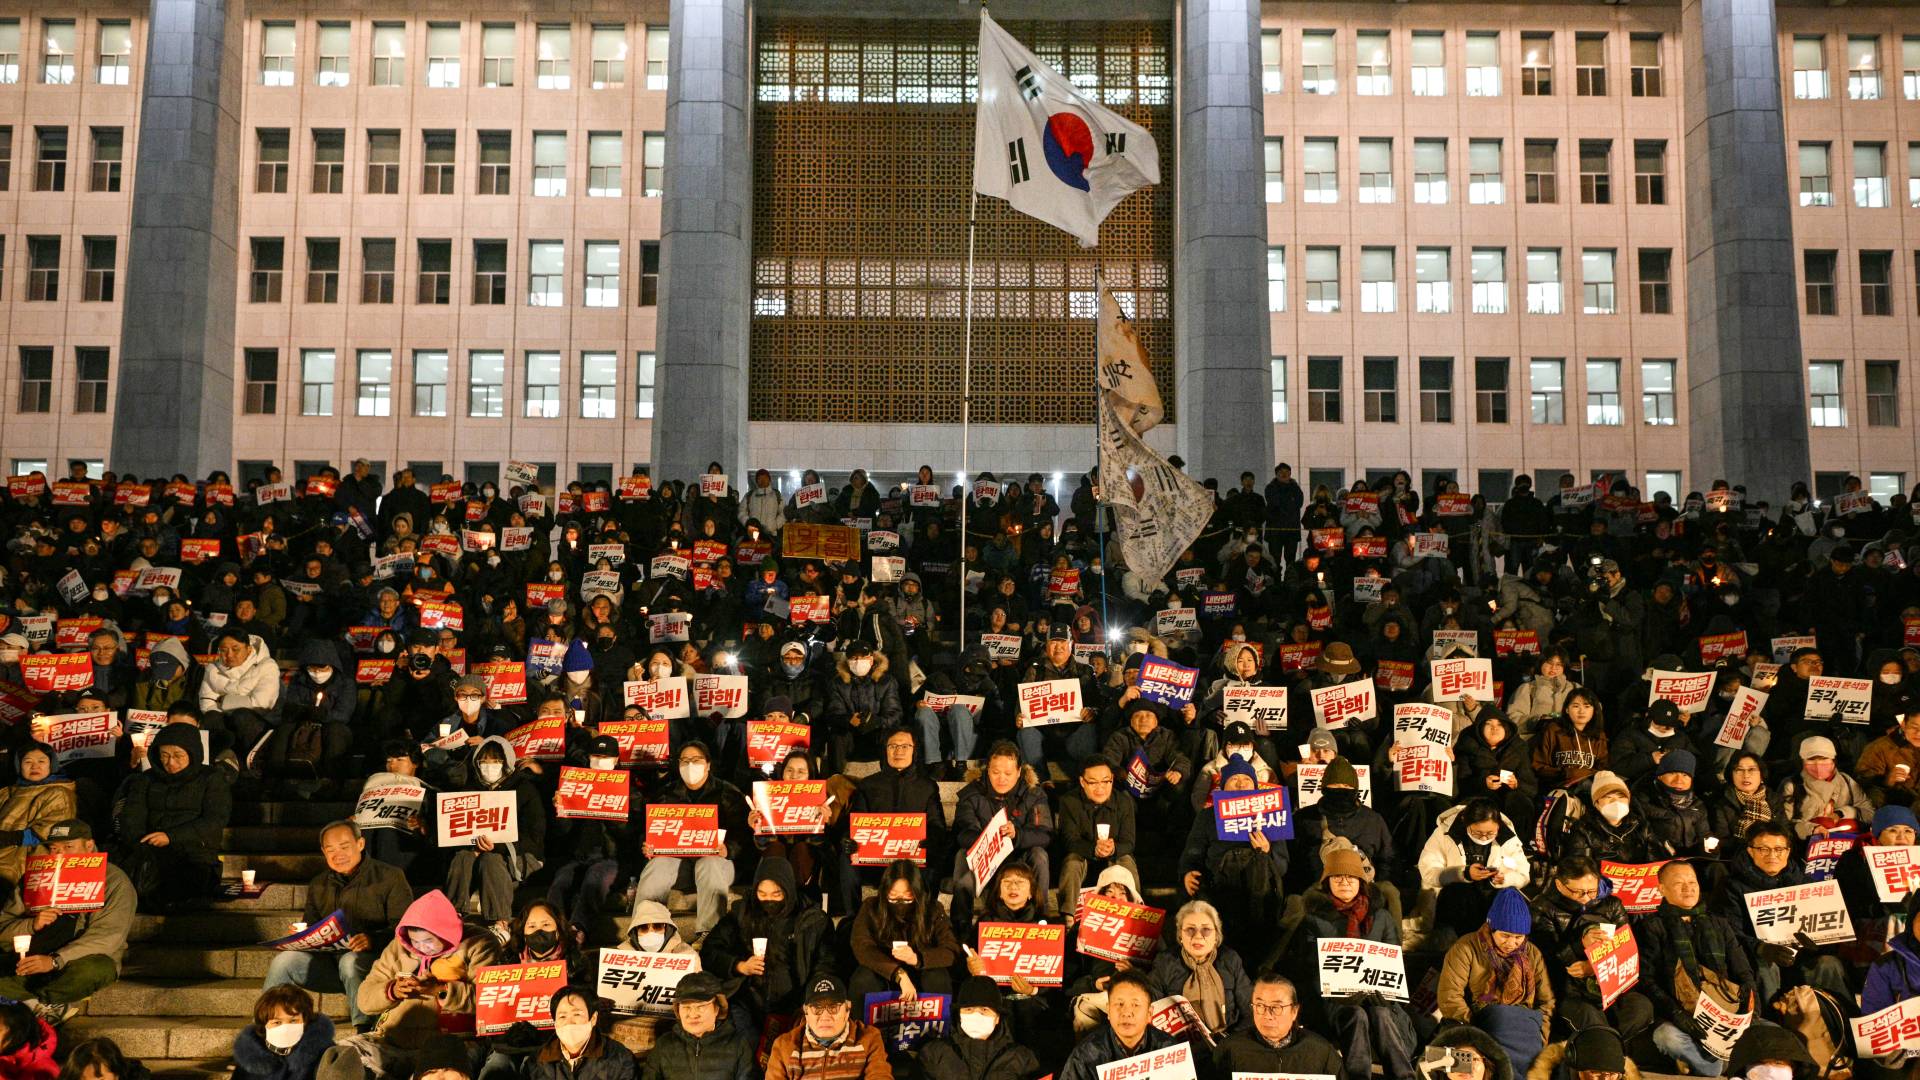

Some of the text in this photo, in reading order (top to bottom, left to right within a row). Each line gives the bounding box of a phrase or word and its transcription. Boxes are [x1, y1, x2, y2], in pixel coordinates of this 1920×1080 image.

[422, 609, 443, 620] 즉각
[791, 603, 811, 616] 즉각
[653, 621, 684, 638] 탄핵!
[1158, 615, 1195, 629] 즉각 체포!
[57, 627, 79, 638] 즉각
[982, 639, 1019, 657] 즉각 체포!
[1495, 638, 1516, 649] 즉각
[21, 654, 88, 667] 내란수괴 윤석열
[499, 664, 523, 673] 윤석열
[1435, 661, 1465, 676] 윤석열
[24, 666, 92, 689] 즉각 탄핵!
[696, 678, 719, 690] 윤석열
[1143, 664, 1194, 686] 내란행위
[1440, 668, 1488, 696] 탄핵!
[1656, 675, 1710, 693] 윤석열은
[491, 683, 523, 698] 탄핵!
[629, 682, 657, 696] 윤석열
[1023, 683, 1051, 699] 윤석열
[1140, 679, 1193, 702] 즉각수사!
[1224, 688, 1285, 699] 내란수괴 윤석열
[1811, 679, 1870, 691] 내란수괴 윤석열
[636, 690, 681, 716] 탄핵!
[697, 688, 742, 711] 탄핵!
[1316, 687, 1345, 705] 윤석열
[1809, 689, 1870, 715] 즉각 체포!
[1028, 691, 1076, 720] 탄핵!
[1225, 698, 1285, 722] 즉각 체포!
[1323, 692, 1369, 724] 탄핵!
[1395, 706, 1451, 721] 내란수괴 윤석열
[50, 716, 108, 739] 윤석열은
[533, 719, 562, 732] 윤석열
[601, 723, 666, 735] 내란수괴 윤석열
[749, 723, 809, 737] 내란수괴 윤석열
[1395, 717, 1450, 747] 즉각 체포!
[524, 737, 563, 755] 탄핵!
[748, 733, 780, 749] 즉각
[630, 742, 667, 760] 탄핵!
[1397, 746, 1428, 761] 윤석열
[560, 769, 627, 784] 내란수괴 윤석열
[1401, 763, 1447, 789] 탄핵!
[392, 786, 422, 799] 윤석열
[560, 781, 628, 812] 즉각 탄핵!
[792, 783, 823, 794] 윤석열
[442, 795, 480, 814] 윤석열
[648, 807, 714, 819] 내란수괴 윤석열
[1220, 793, 1281, 816] 내란행위
[448, 806, 509, 838] 탄핵!
[852, 816, 924, 828] 내란수괴 윤석열
[649, 819, 716, 848] 즉각 탄핵!
[853, 828, 889, 846] 즉각
[1807, 840, 1852, 858] 내란행
[1873, 850, 1910, 866] 윤석열
[64, 856, 104, 869] 윤석열
[1603, 864, 1647, 878] 내란수괴
[27, 871, 104, 901] 즉각 탄핵!
[1749, 884, 1835, 909] 내란수괴 윤석열
[1086, 896, 1130, 916] 내란수괴
[1131, 906, 1162, 923] 윤석열
[1755, 905, 1846, 935] 즉각 체포!
[980, 925, 1061, 941] 내란수괴 윤석열
[1082, 911, 1156, 954] 즉각 탄핵!
[980, 939, 1062, 976] 즉각 탄핵!
[1320, 941, 1399, 960] 내란수괴 윤석열
[602, 952, 691, 973] 내란수괴 윤석열
[477, 962, 562, 985] 내란수괴 윤석열
[600, 967, 646, 991] 즉각
[1321, 954, 1404, 990] 즉각 체포!
[476, 985, 522, 1008] 즉각
[1699, 997, 1744, 1027] 내란수괴
[1695, 1010, 1741, 1043] 즉각
[1859, 1007, 1903, 1037] 윤석열
[1102, 1047, 1188, 1080] 내란수괴 윤석열
